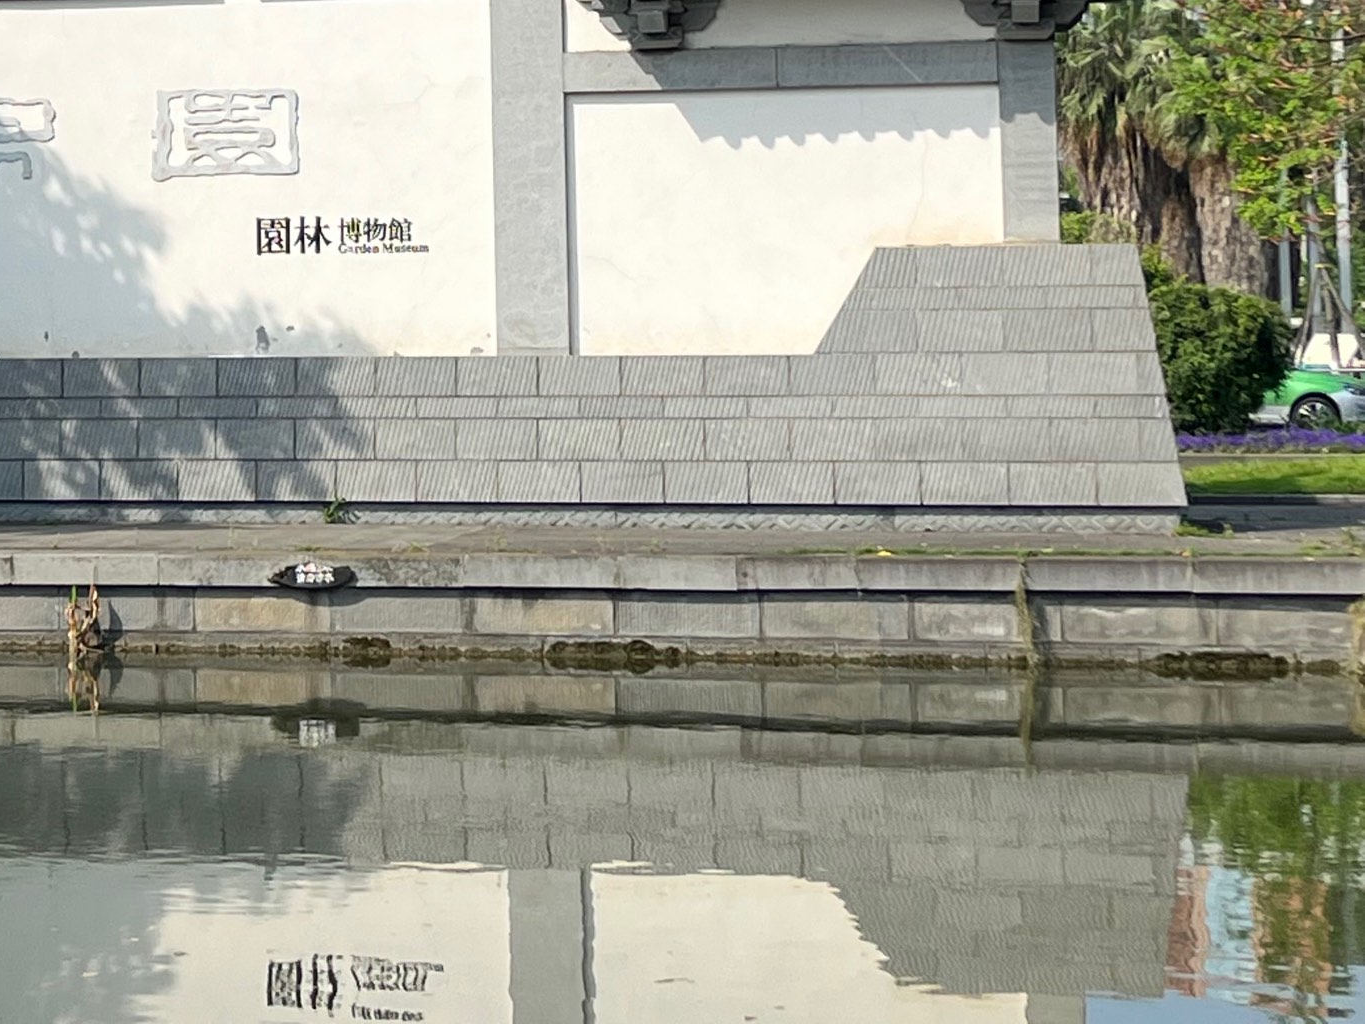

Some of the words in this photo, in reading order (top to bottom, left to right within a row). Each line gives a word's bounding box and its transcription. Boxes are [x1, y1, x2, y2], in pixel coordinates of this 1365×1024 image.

[255, 216, 332, 256] 園林
[338, 217, 413, 243] 博物館
[338, 243, 380, 254] Garden
[382, 243, 430, 254] Museum
